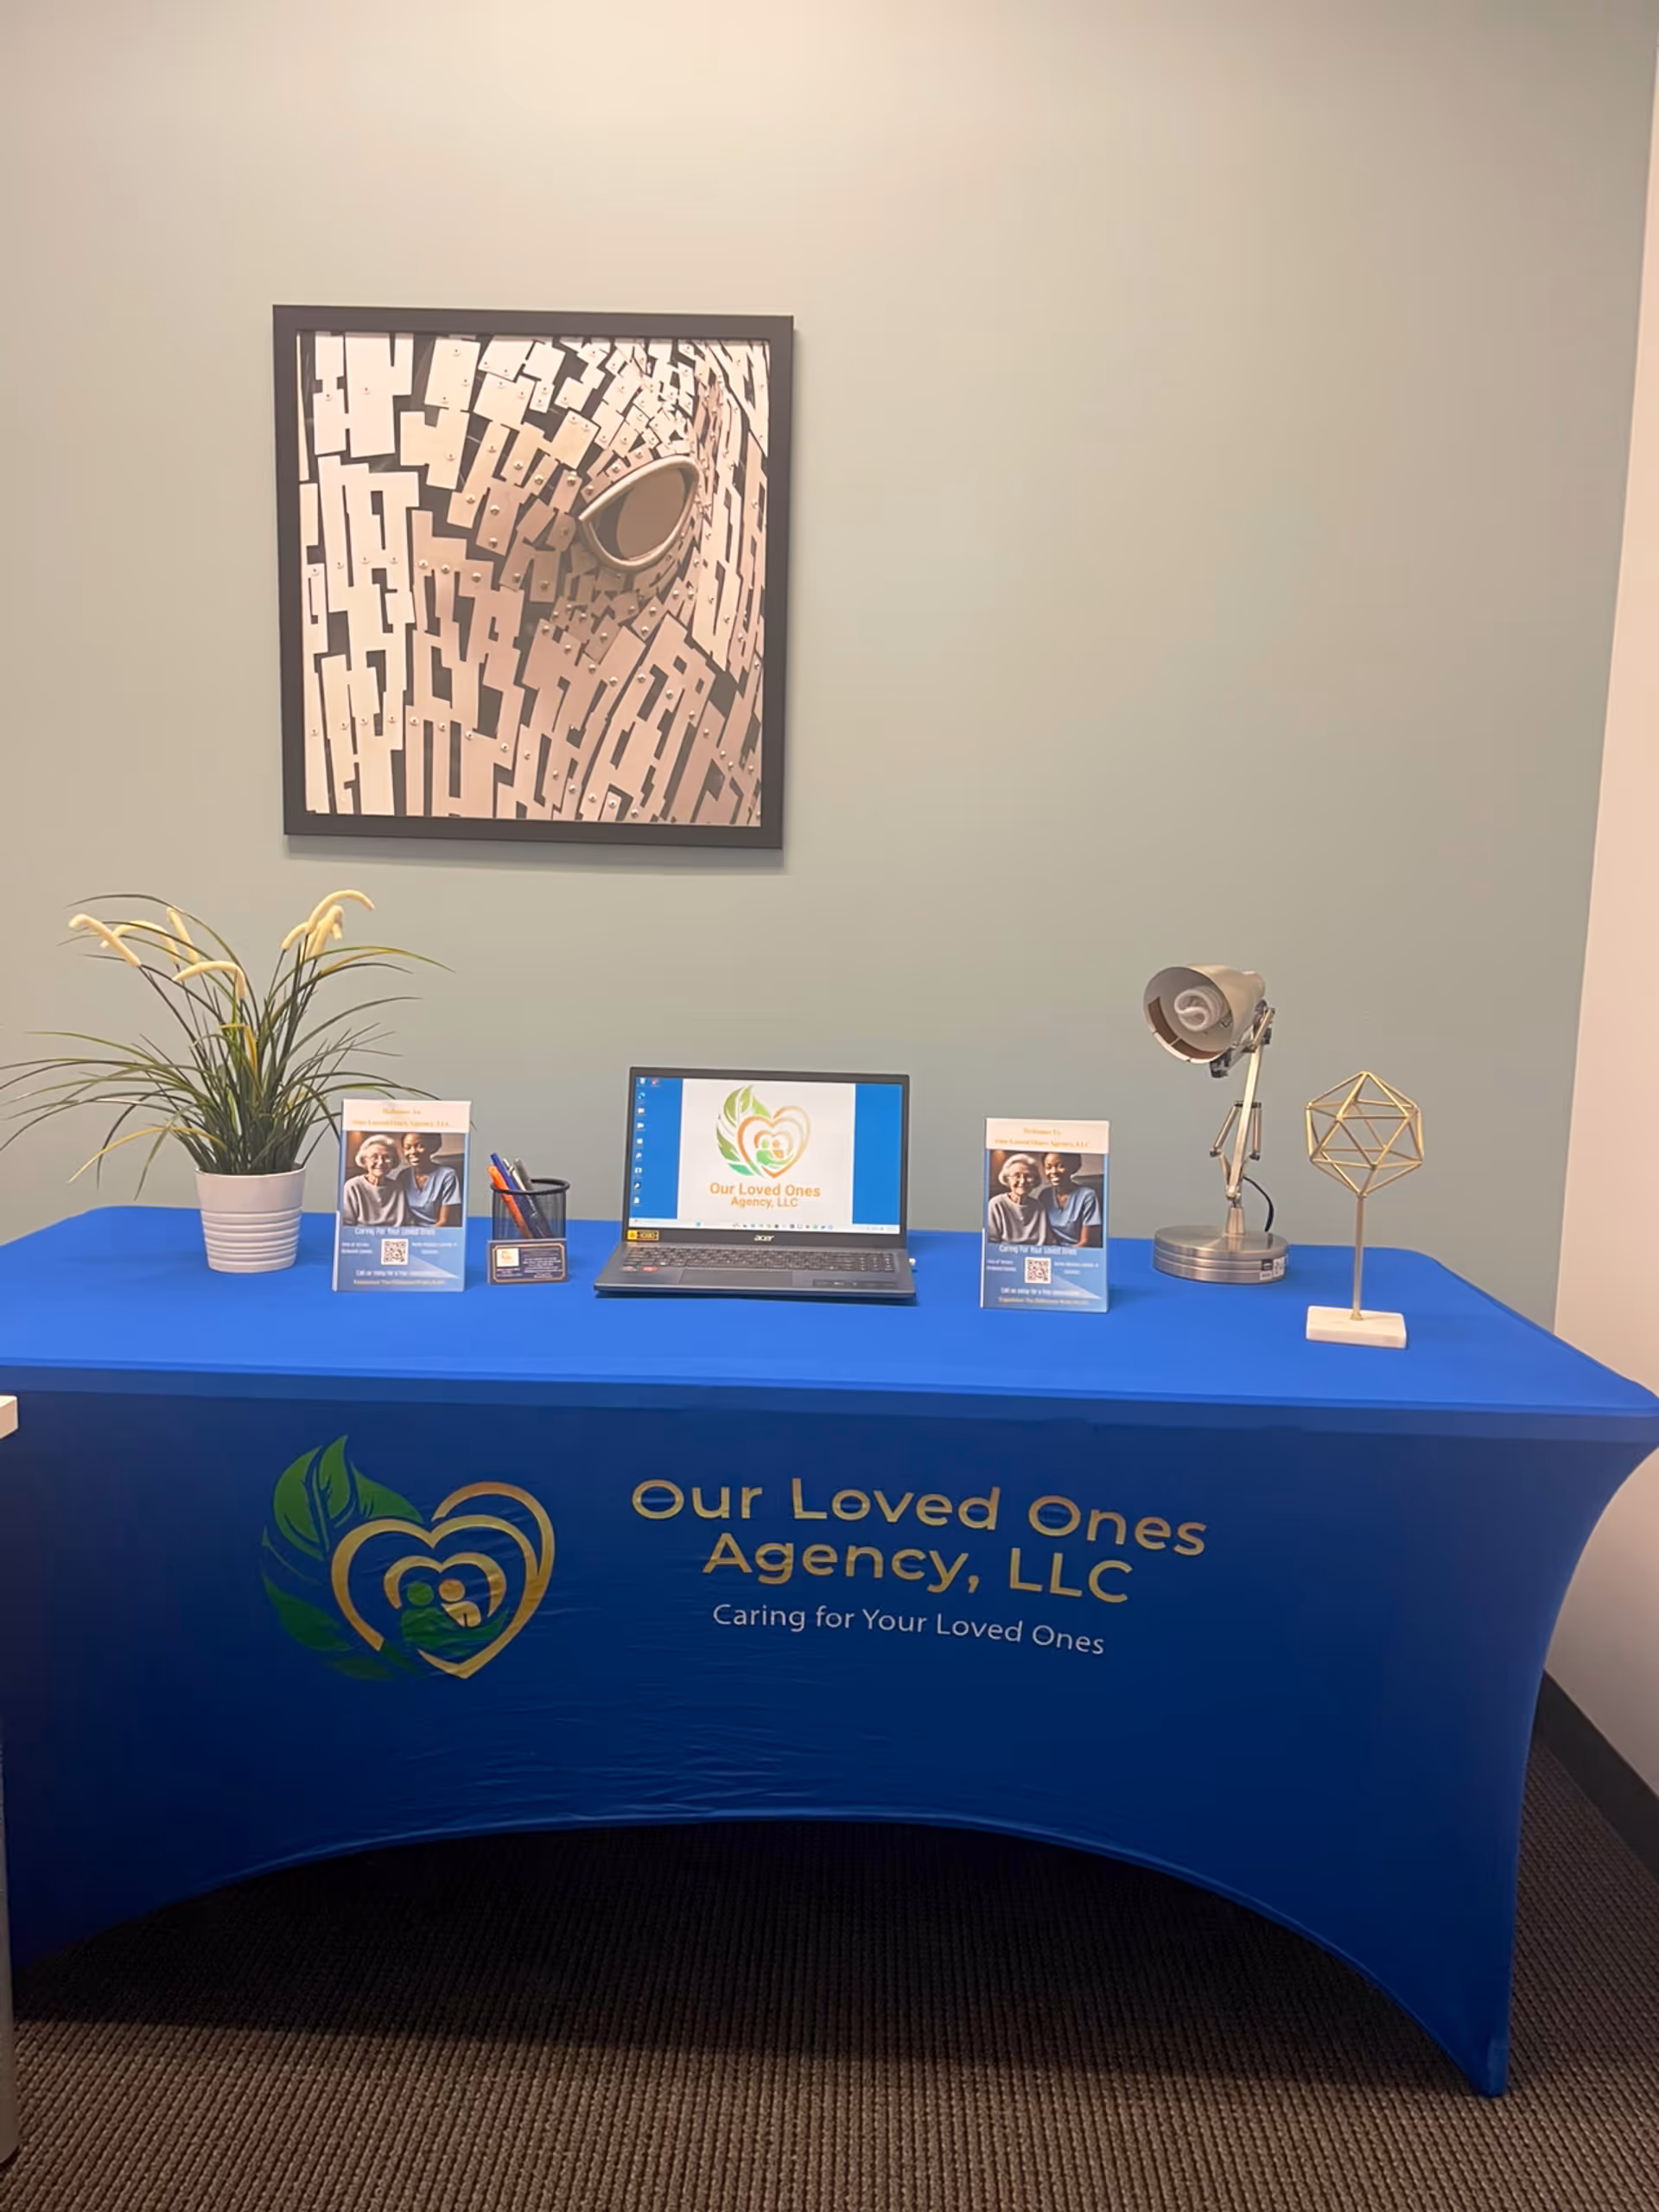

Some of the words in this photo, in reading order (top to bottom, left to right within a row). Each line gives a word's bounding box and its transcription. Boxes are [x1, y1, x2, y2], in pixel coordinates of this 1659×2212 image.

[709, 1182, 735, 1196] Our
[739, 1182, 781, 1198] Loved
[785, 1185, 821, 1198] Ones
[730, 1195, 774, 1210] Agency,
[777, 1197, 798, 1208] LLC
[632, 1479, 763, 1519] Our
[792, 1478, 1001, 1530] Loved
[1028, 1496, 1206, 1556] Ones
[702, 1533, 979, 1593] Agency,
[1009, 1548, 1133, 1603] LLC
[713, 1604, 805, 1632] Caring
[816, 1605, 855, 1629] for
[862, 1609, 927, 1632] Your
[937, 1613, 1023, 1642] Loved
[1033, 1624, 1103, 1655] Ones
